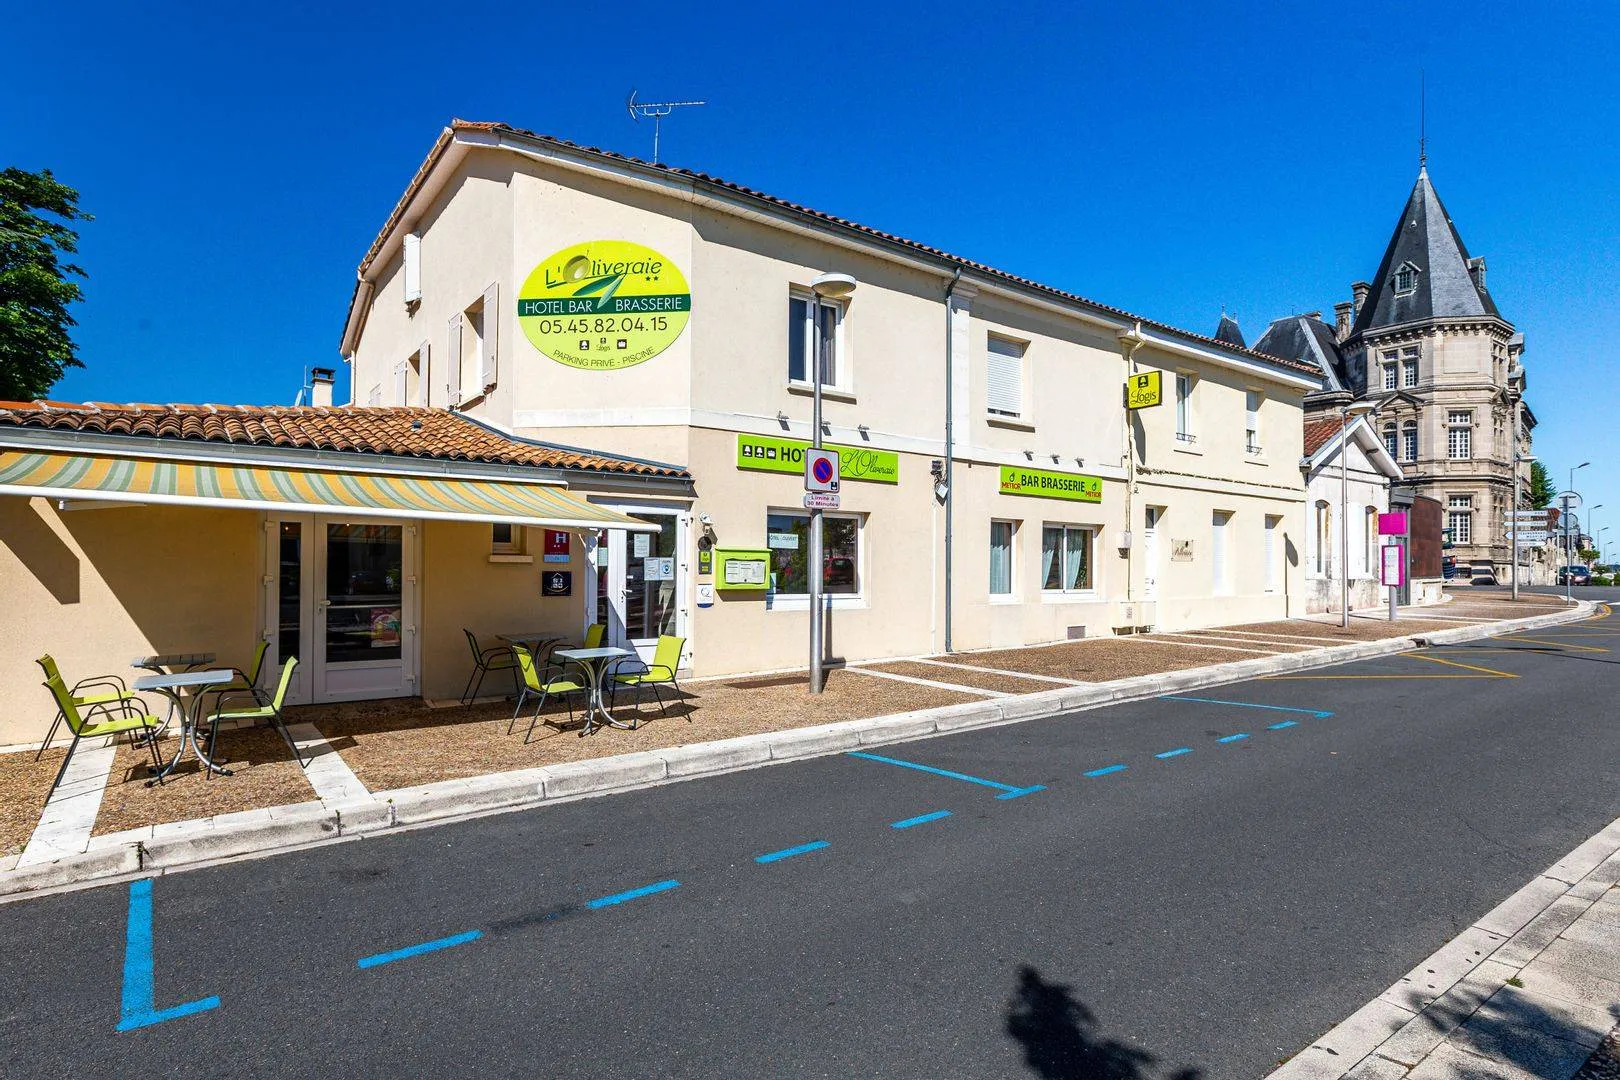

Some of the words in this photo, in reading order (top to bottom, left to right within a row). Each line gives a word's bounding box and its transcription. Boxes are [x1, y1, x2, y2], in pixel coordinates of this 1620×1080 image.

[525, 301, 565, 315] HOTEL
[568, 300, 593, 313] BAR
[615, 297, 682, 312] BRASSERIE
[539, 316, 668, 335] 05.45.82.04.15
[553, 349, 589, 367] PARKING
[622, 346, 655, 365] PISCINE
[1130, 388, 1157, 405] Logis
[1021, 474, 1040, 488] BAR
[1041, 476, 1086, 493] BRASSERIE
[555, 532, 567, 544] H
